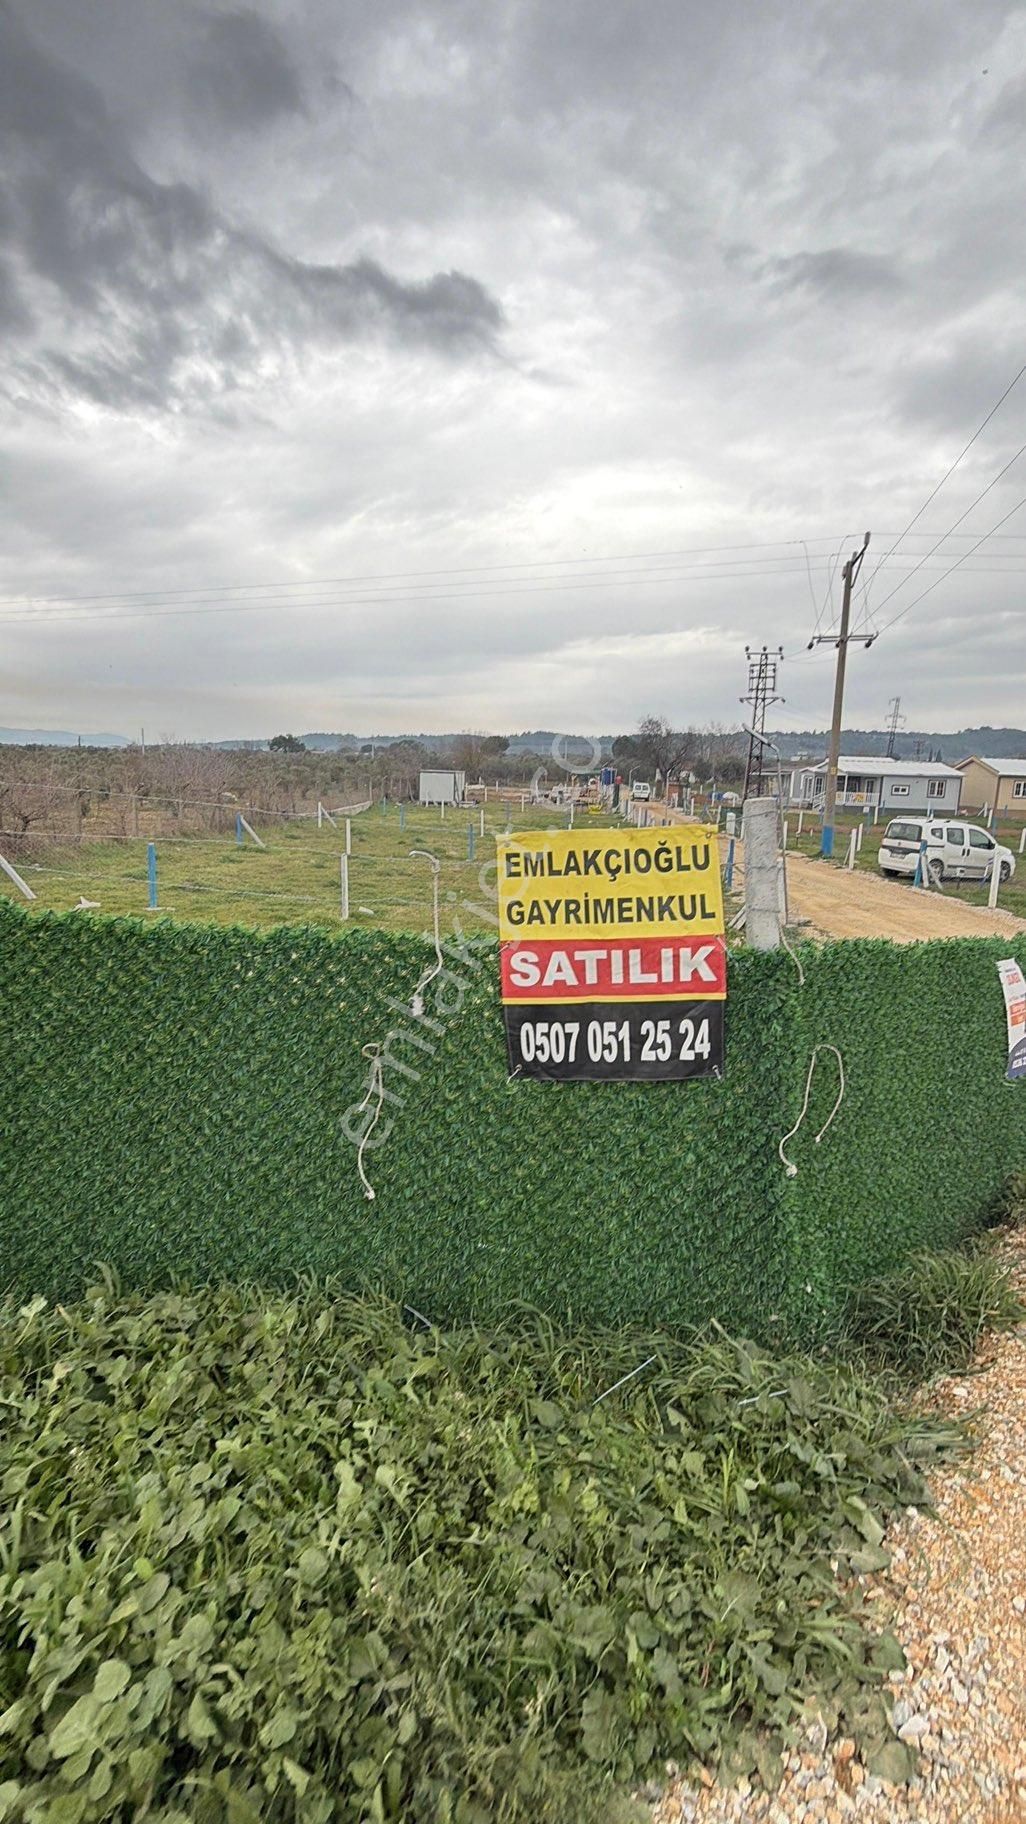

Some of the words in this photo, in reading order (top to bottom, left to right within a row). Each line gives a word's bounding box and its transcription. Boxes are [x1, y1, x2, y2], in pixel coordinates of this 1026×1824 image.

[505, 840, 711, 882] EMLAKÇIOĞLU
[506, 892, 717, 926] GAYRİMENKUL
[509, 945, 718, 987] SATILIK
[520, 1021, 580, 1063] 0507
[587, 1020, 631, 1063] 051
[640, 1019, 672, 1062] 25
[679, 1018, 711, 1062] 24
